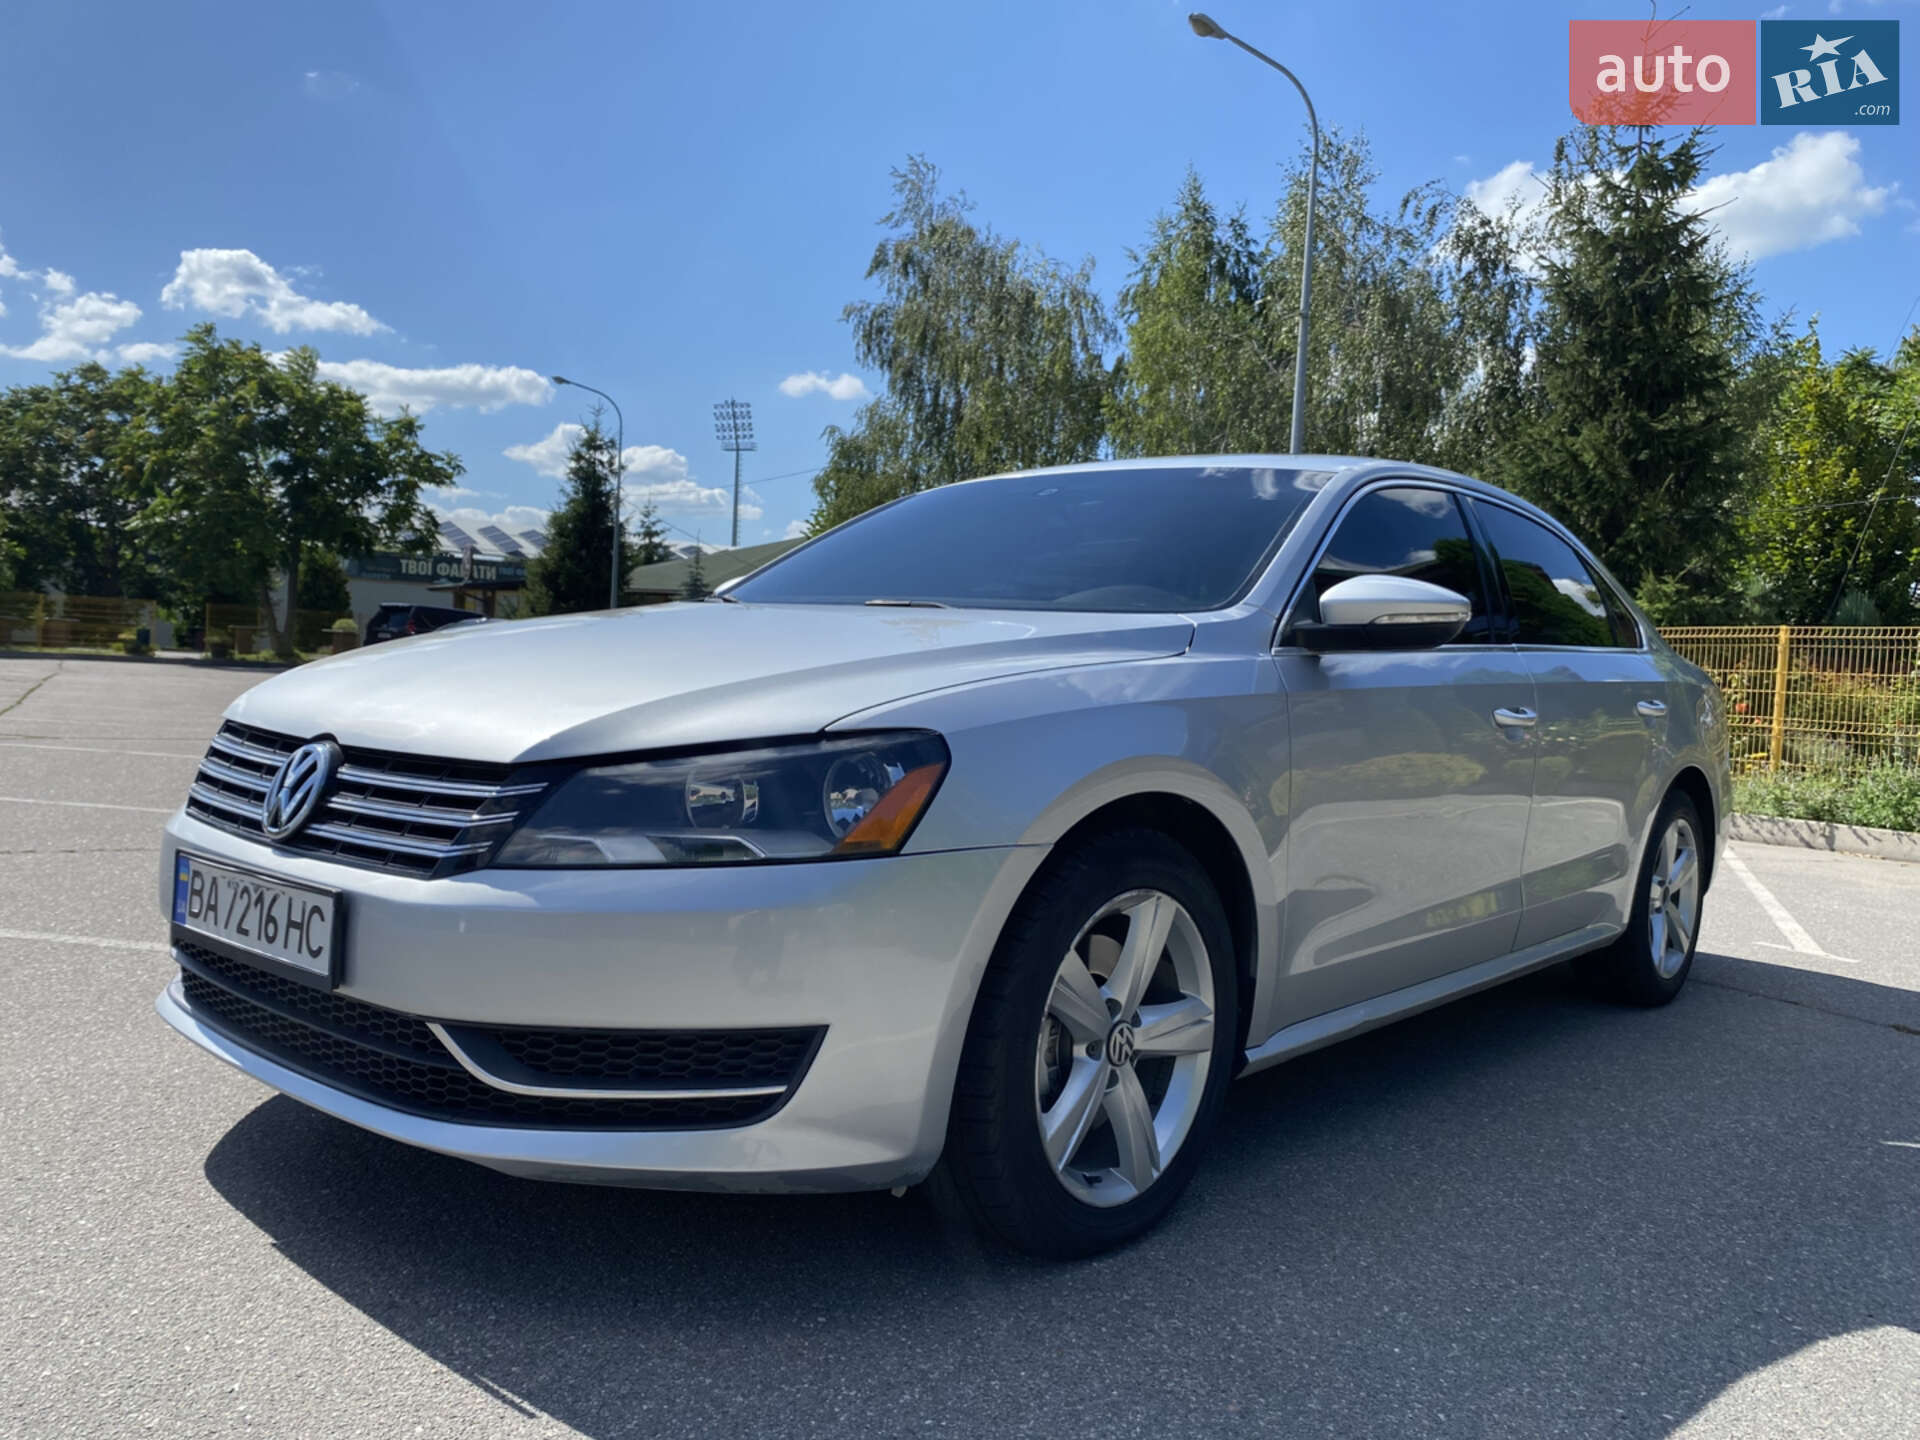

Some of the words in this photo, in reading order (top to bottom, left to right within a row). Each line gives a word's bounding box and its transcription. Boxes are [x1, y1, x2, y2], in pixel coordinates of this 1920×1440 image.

[400, 559, 432, 576] ТВОЇ
[436, 562, 497, 580] ФААТИ
[188, 869, 218, 926] BA
[223, 881, 281, 945] 7216
[283, 896, 326, 959] HC
